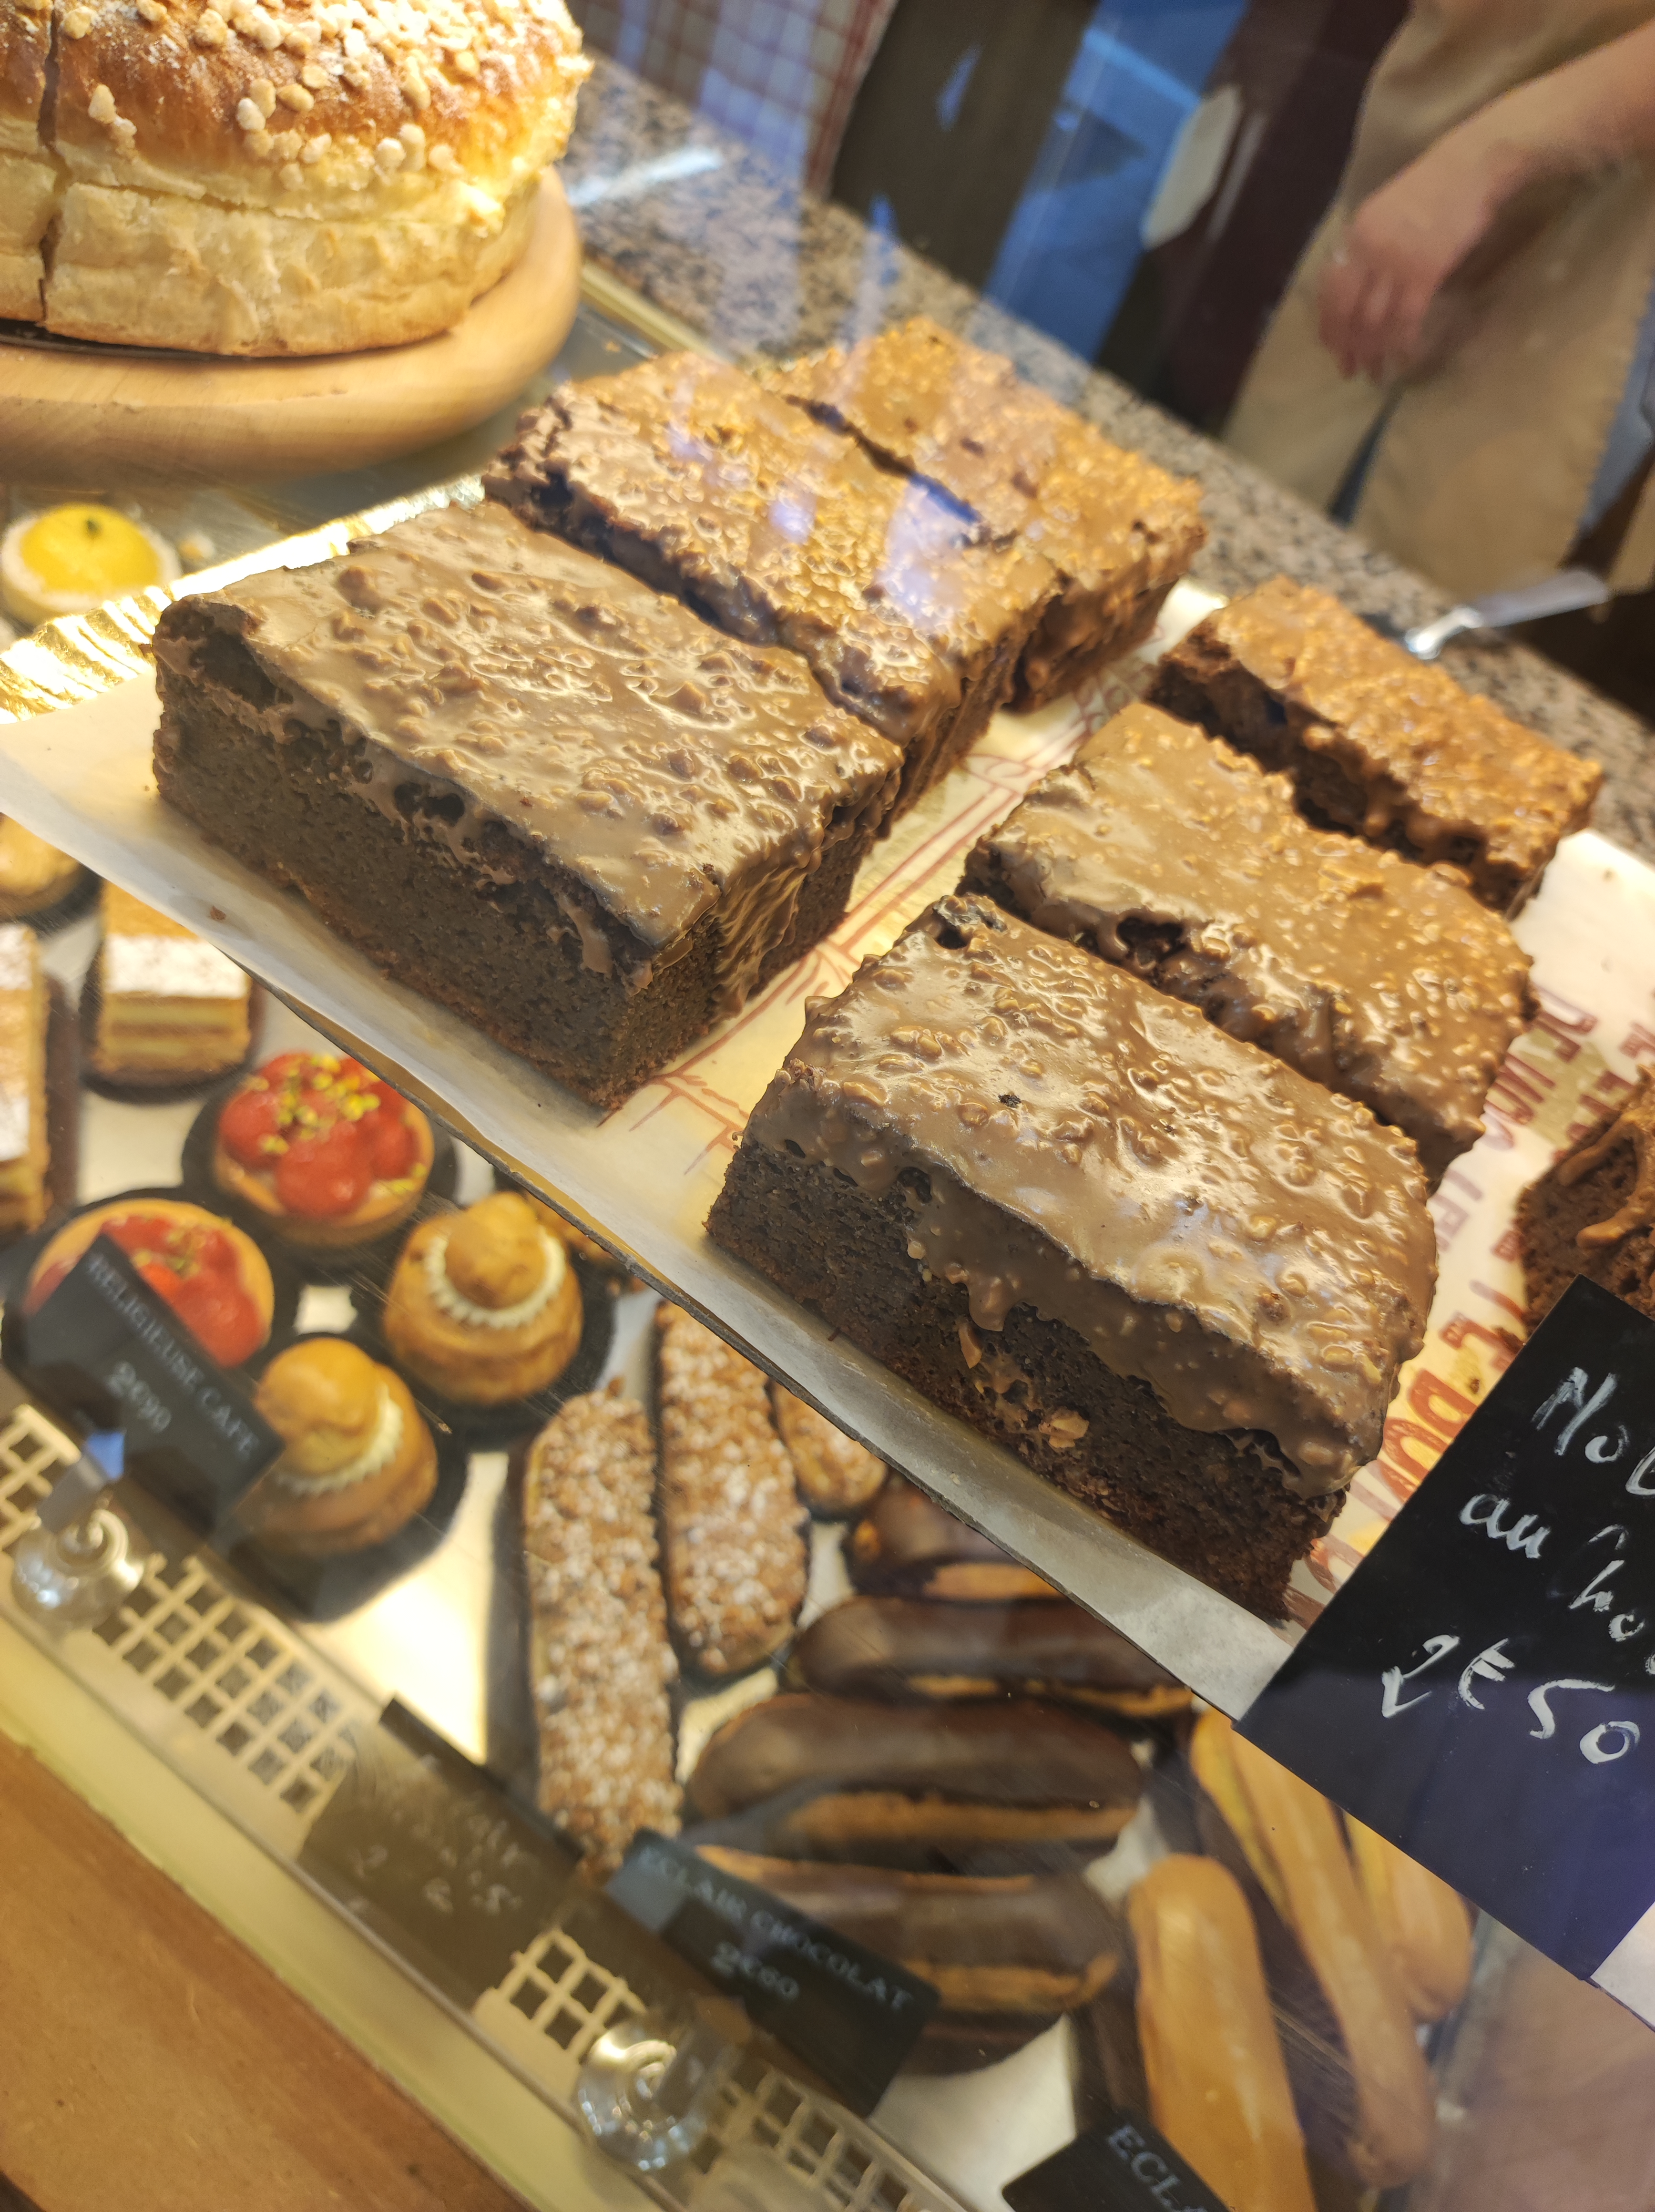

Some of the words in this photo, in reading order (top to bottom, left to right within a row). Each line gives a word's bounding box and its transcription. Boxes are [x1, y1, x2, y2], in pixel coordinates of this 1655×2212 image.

[1459, 1493, 1551, 1558] au
[751, 1909, 912, 2011] CHOCOLAT
[1109, 2124, 1207, 2212] ECL
